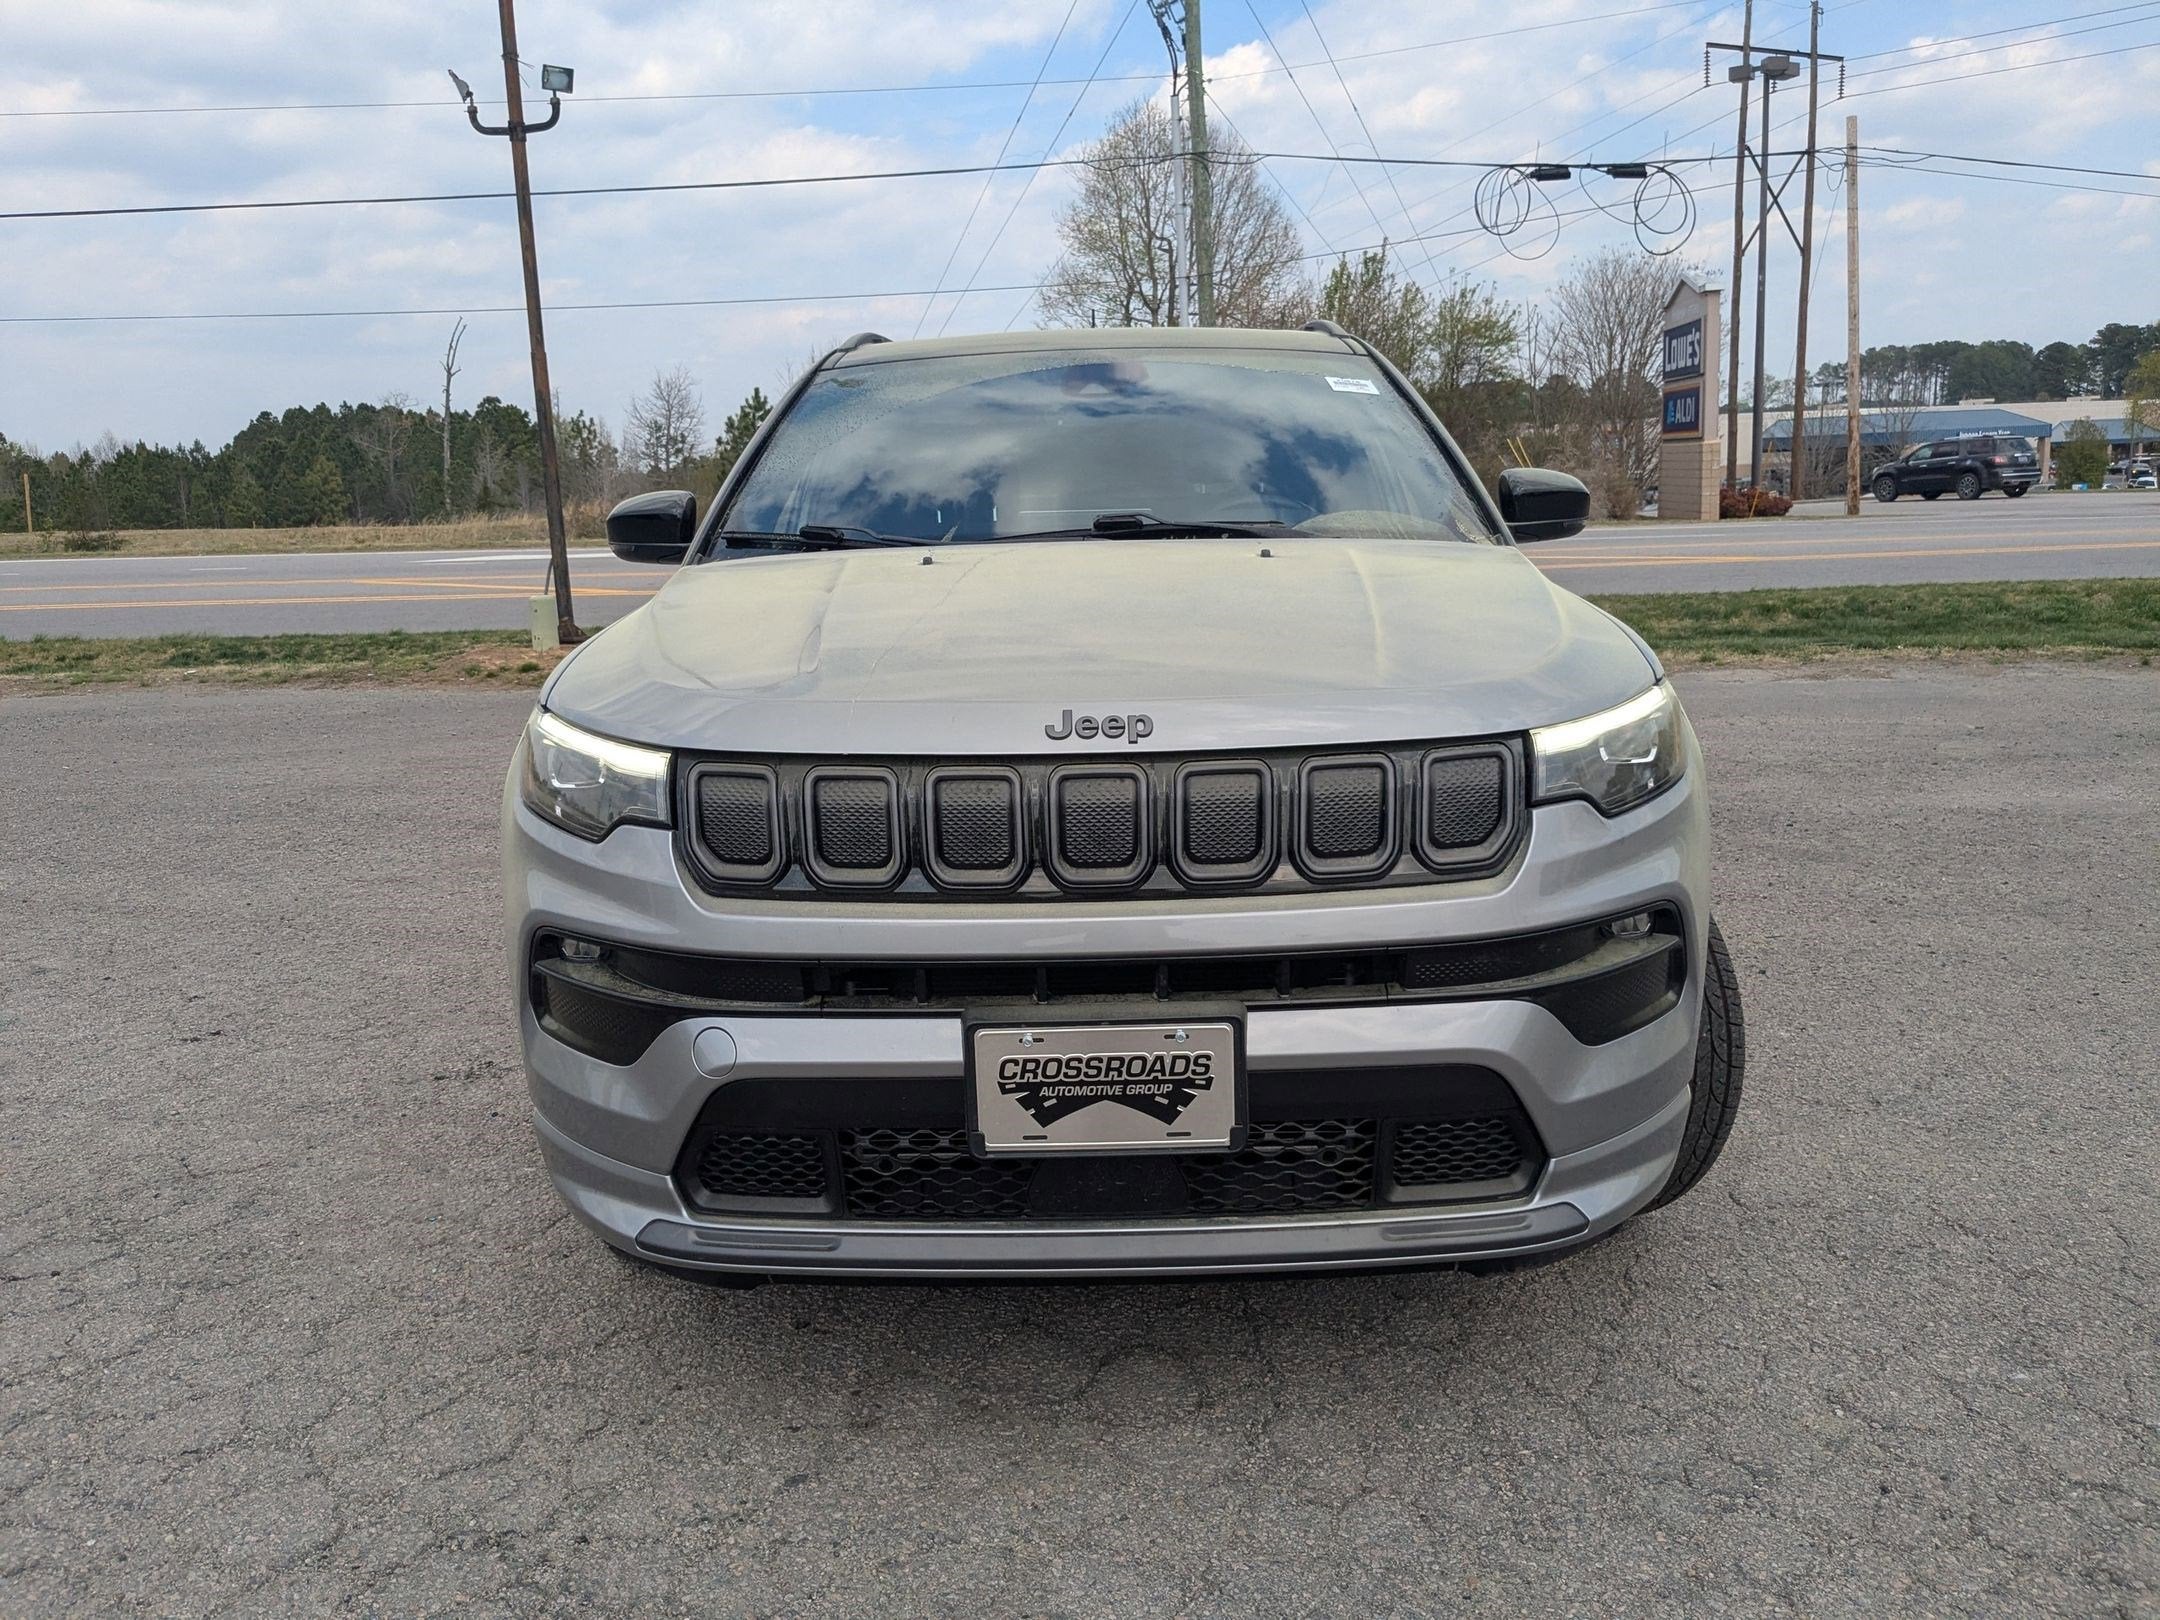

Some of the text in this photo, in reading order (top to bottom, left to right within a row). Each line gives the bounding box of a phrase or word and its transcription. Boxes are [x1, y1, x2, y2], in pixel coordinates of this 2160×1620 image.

[1665, 328, 1700, 372] LOWE'S
[1675, 397, 1696, 424] ALDI
[1045, 709, 1154, 744] Jeep
[998, 1054, 1213, 1083] CROSSROADS
[1039, 1083, 1173, 1097] AUTOMOTIVE GROUP
